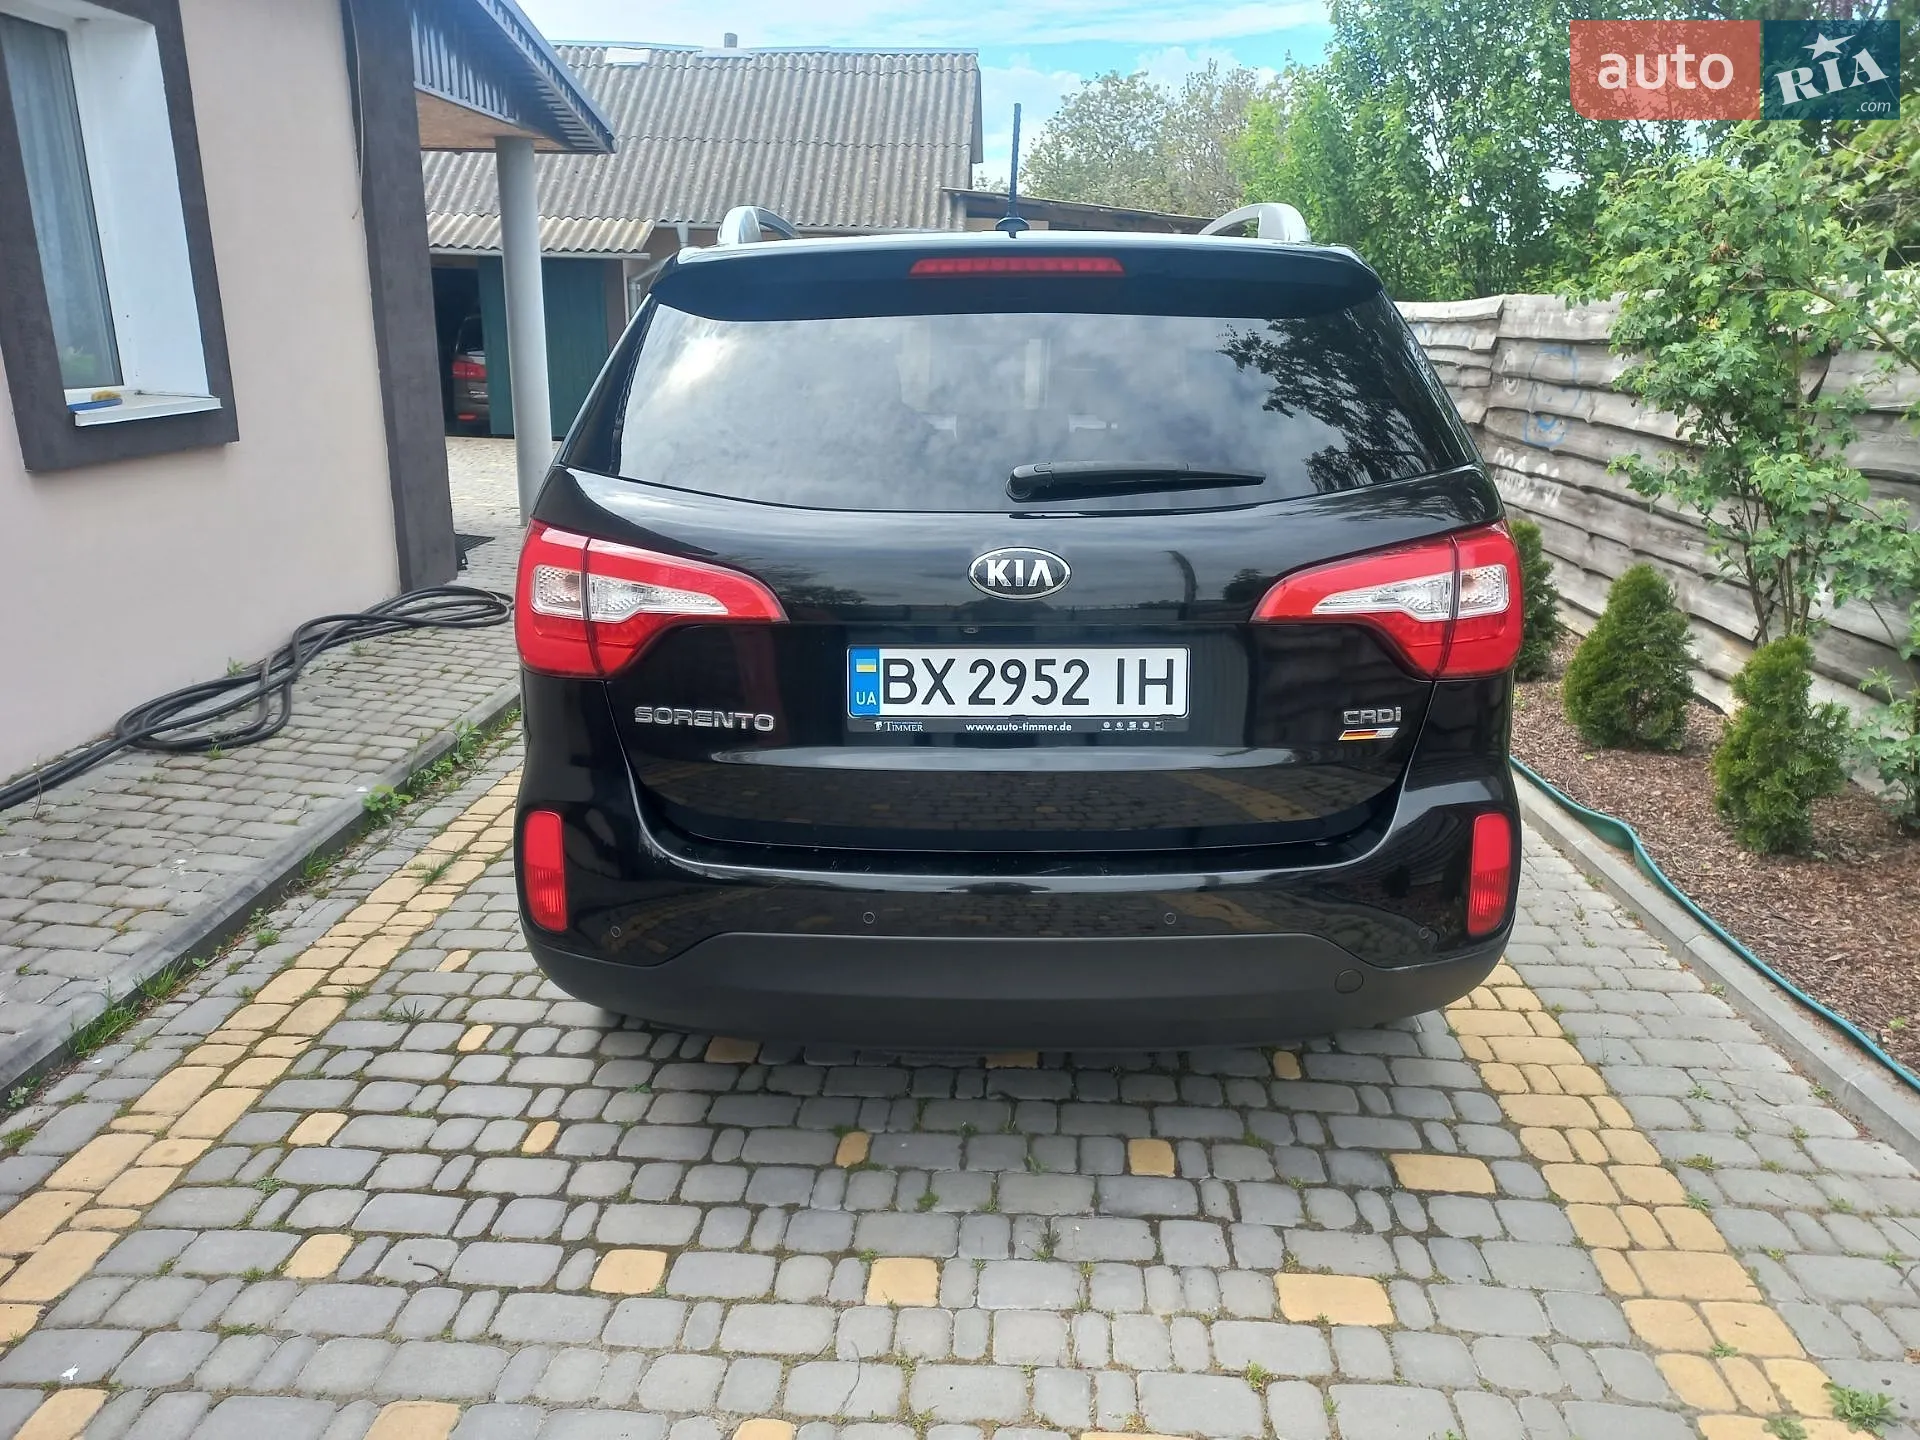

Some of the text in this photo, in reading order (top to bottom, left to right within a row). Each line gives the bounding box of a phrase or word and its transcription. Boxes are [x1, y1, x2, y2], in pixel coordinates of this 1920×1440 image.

[986, 559, 1054, 587] KIA
[882, 658, 1175, 706] BX 2952 IH
[856, 691, 877, 705] UA
[634, 706, 775, 732] SORENTO
[965, 722, 1072, 731] www.auto-timmer.de
[1343, 706, 1402, 725] CRDi
